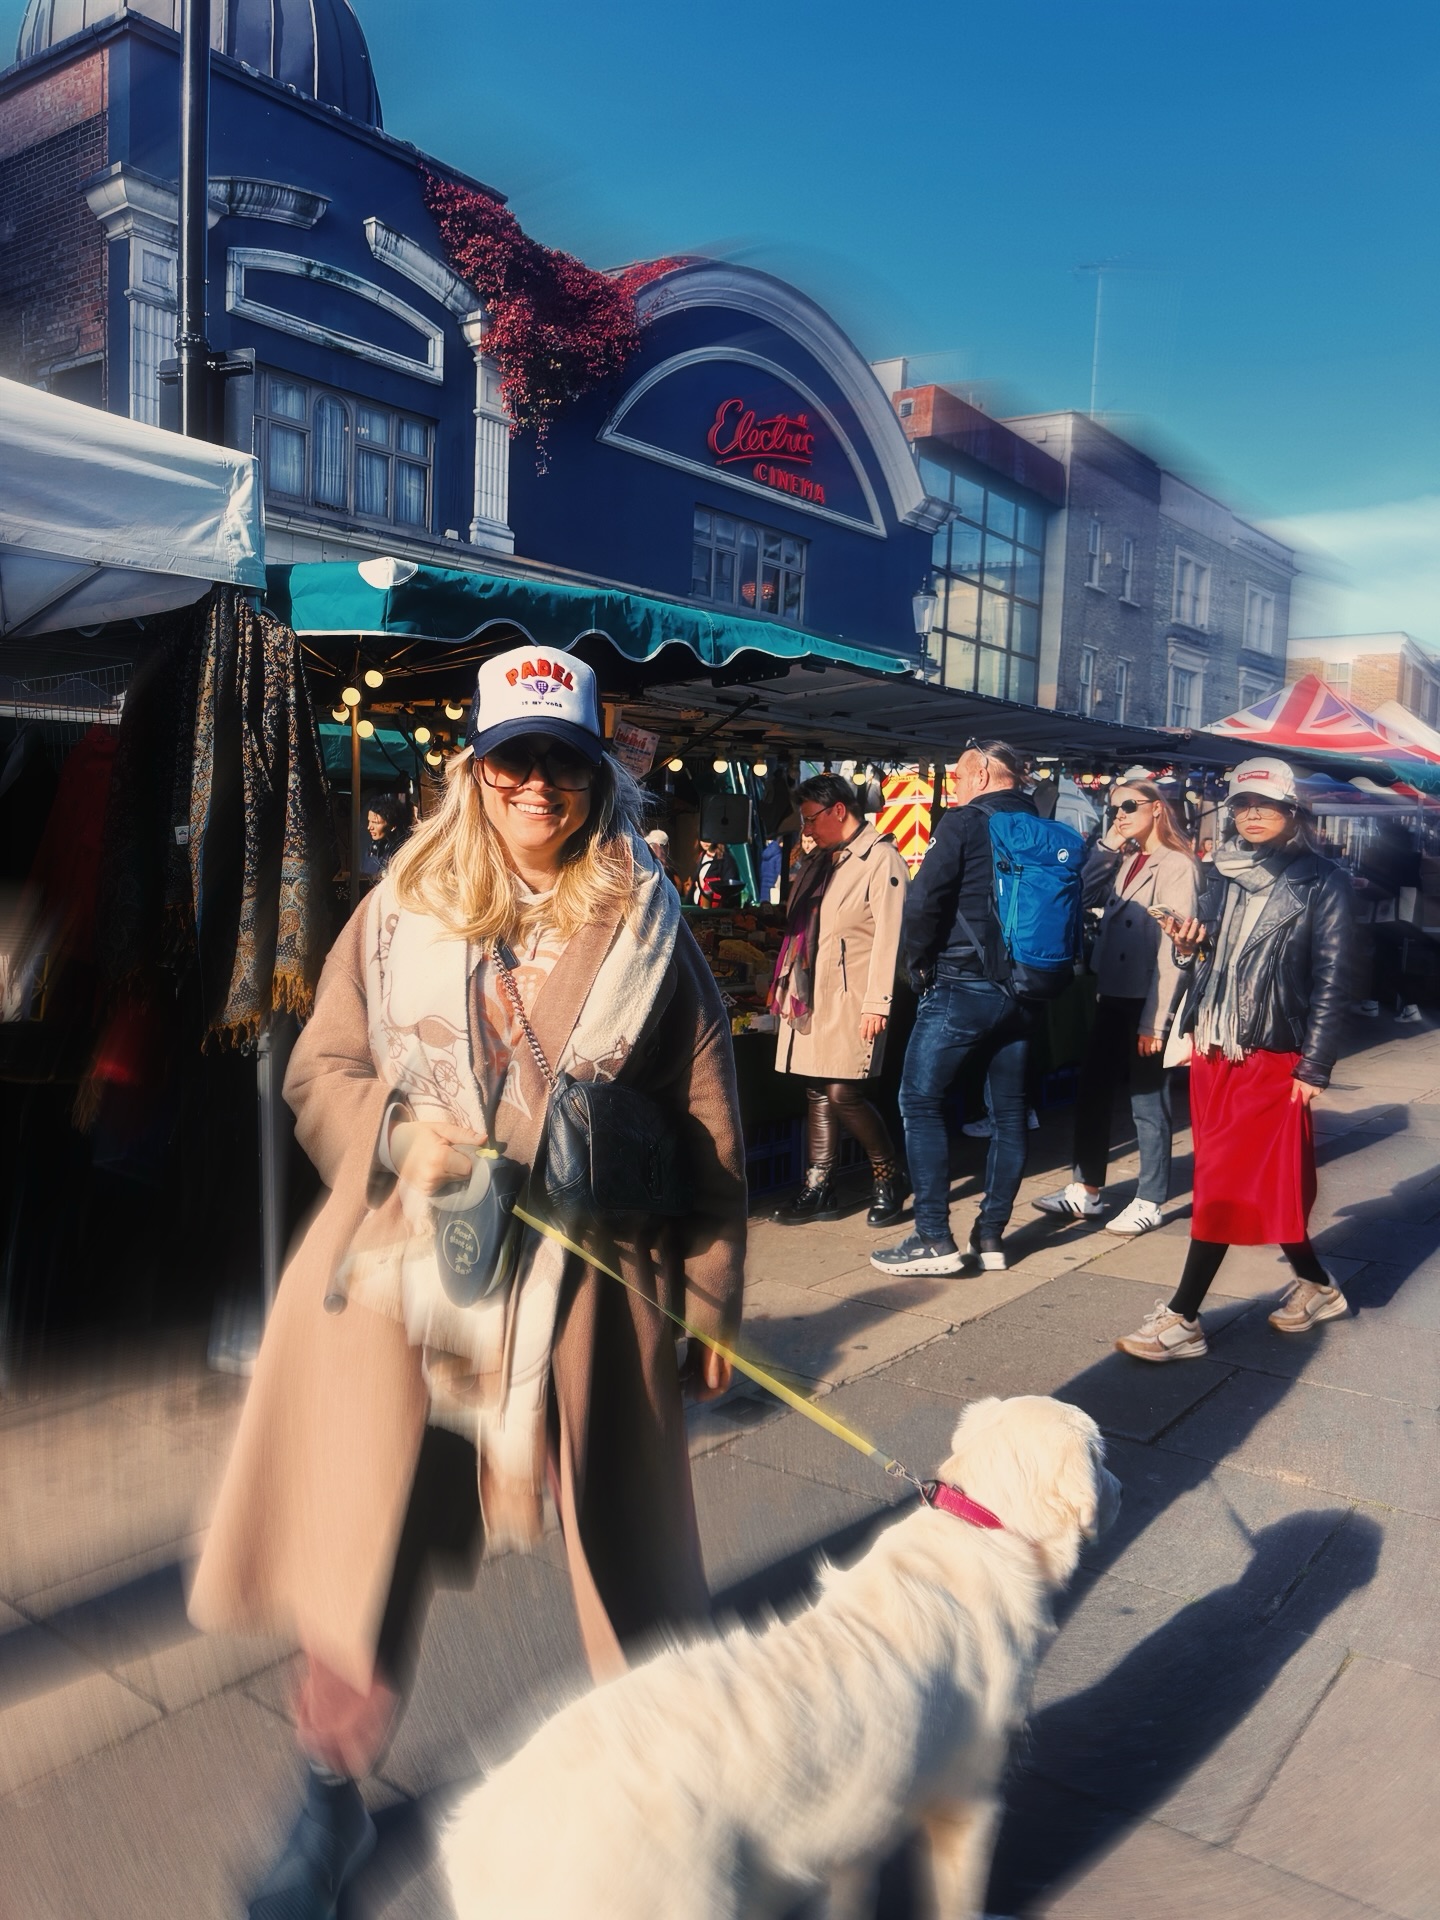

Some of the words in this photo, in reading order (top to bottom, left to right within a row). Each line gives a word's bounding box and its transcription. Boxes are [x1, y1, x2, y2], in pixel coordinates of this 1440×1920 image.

[708, 398, 815, 455] Electric
[753, 463, 825, 504] CINEMA
[506, 658, 574, 692] PADEL
